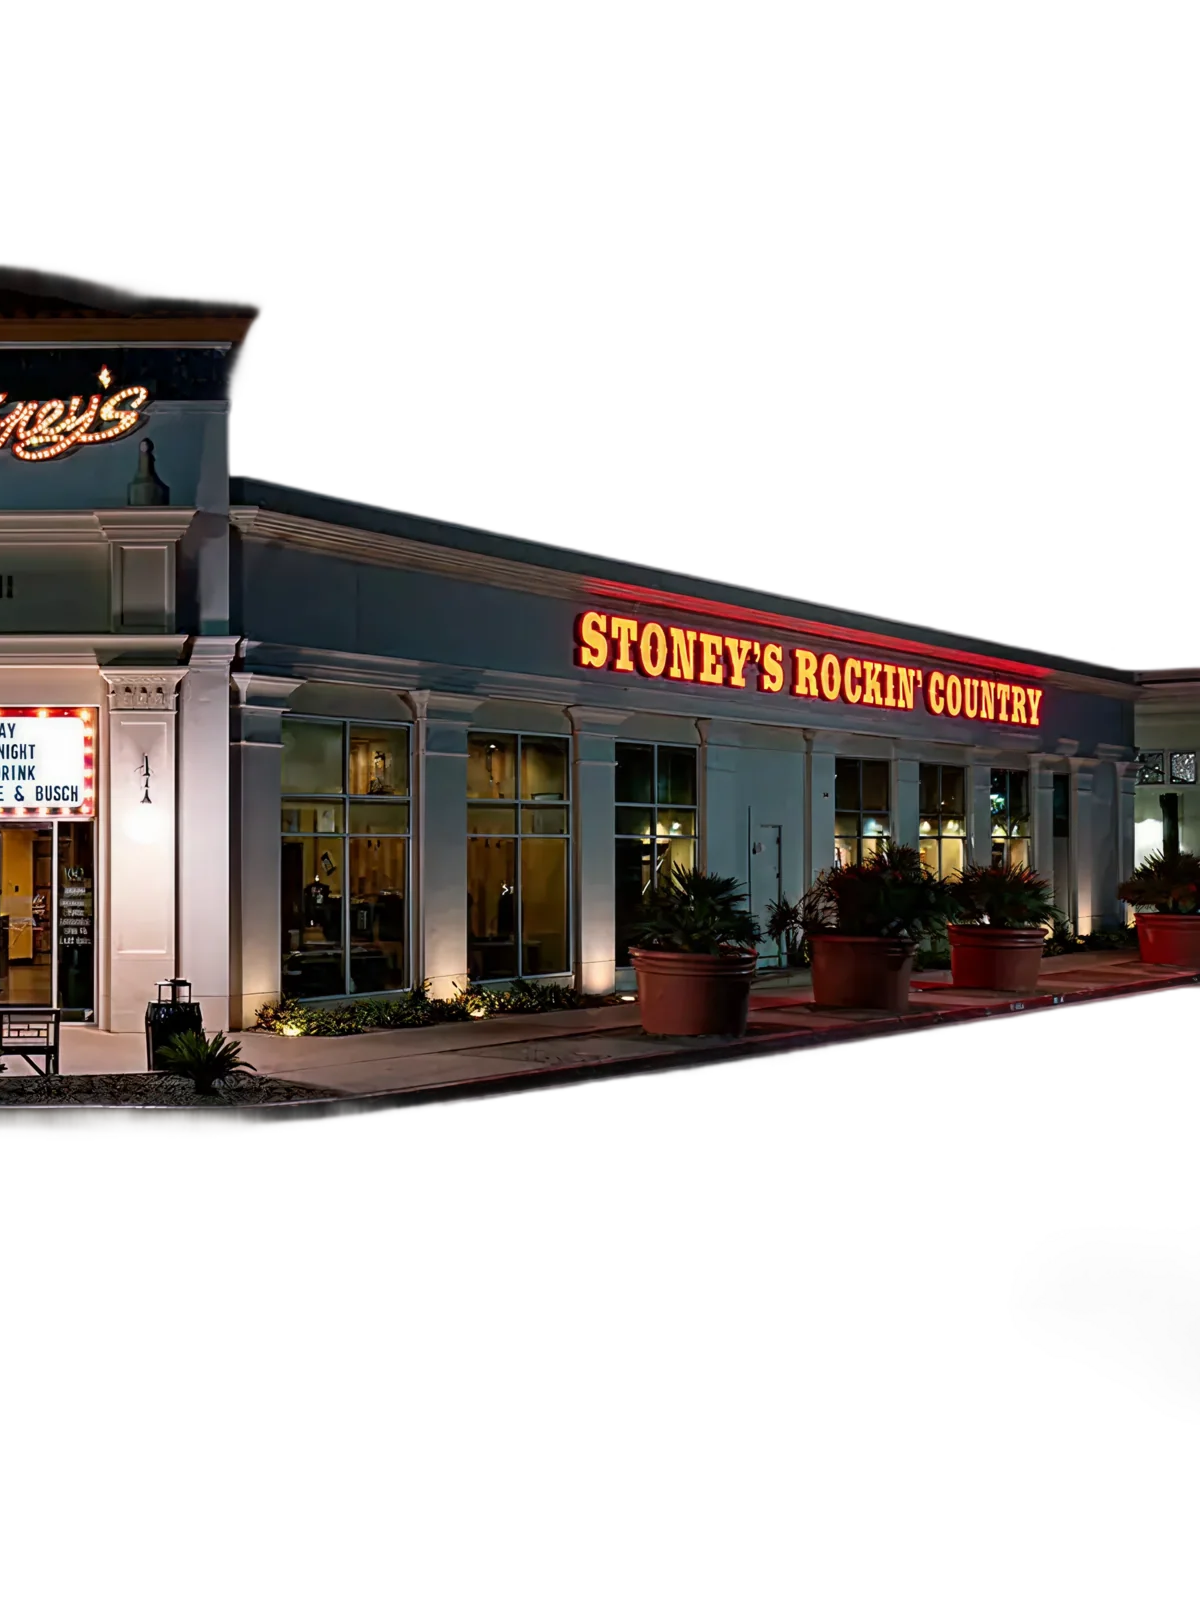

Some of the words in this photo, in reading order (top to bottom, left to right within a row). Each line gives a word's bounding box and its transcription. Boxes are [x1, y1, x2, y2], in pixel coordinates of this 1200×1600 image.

[577, 611, 784, 693] STONEY'S
[794, 648, 923, 711] ROCKIN'
[927, 671, 1043, 728] COUNTRY
[13, 785, 25, 802] &
[35, 785, 79, 803] BUSCH
